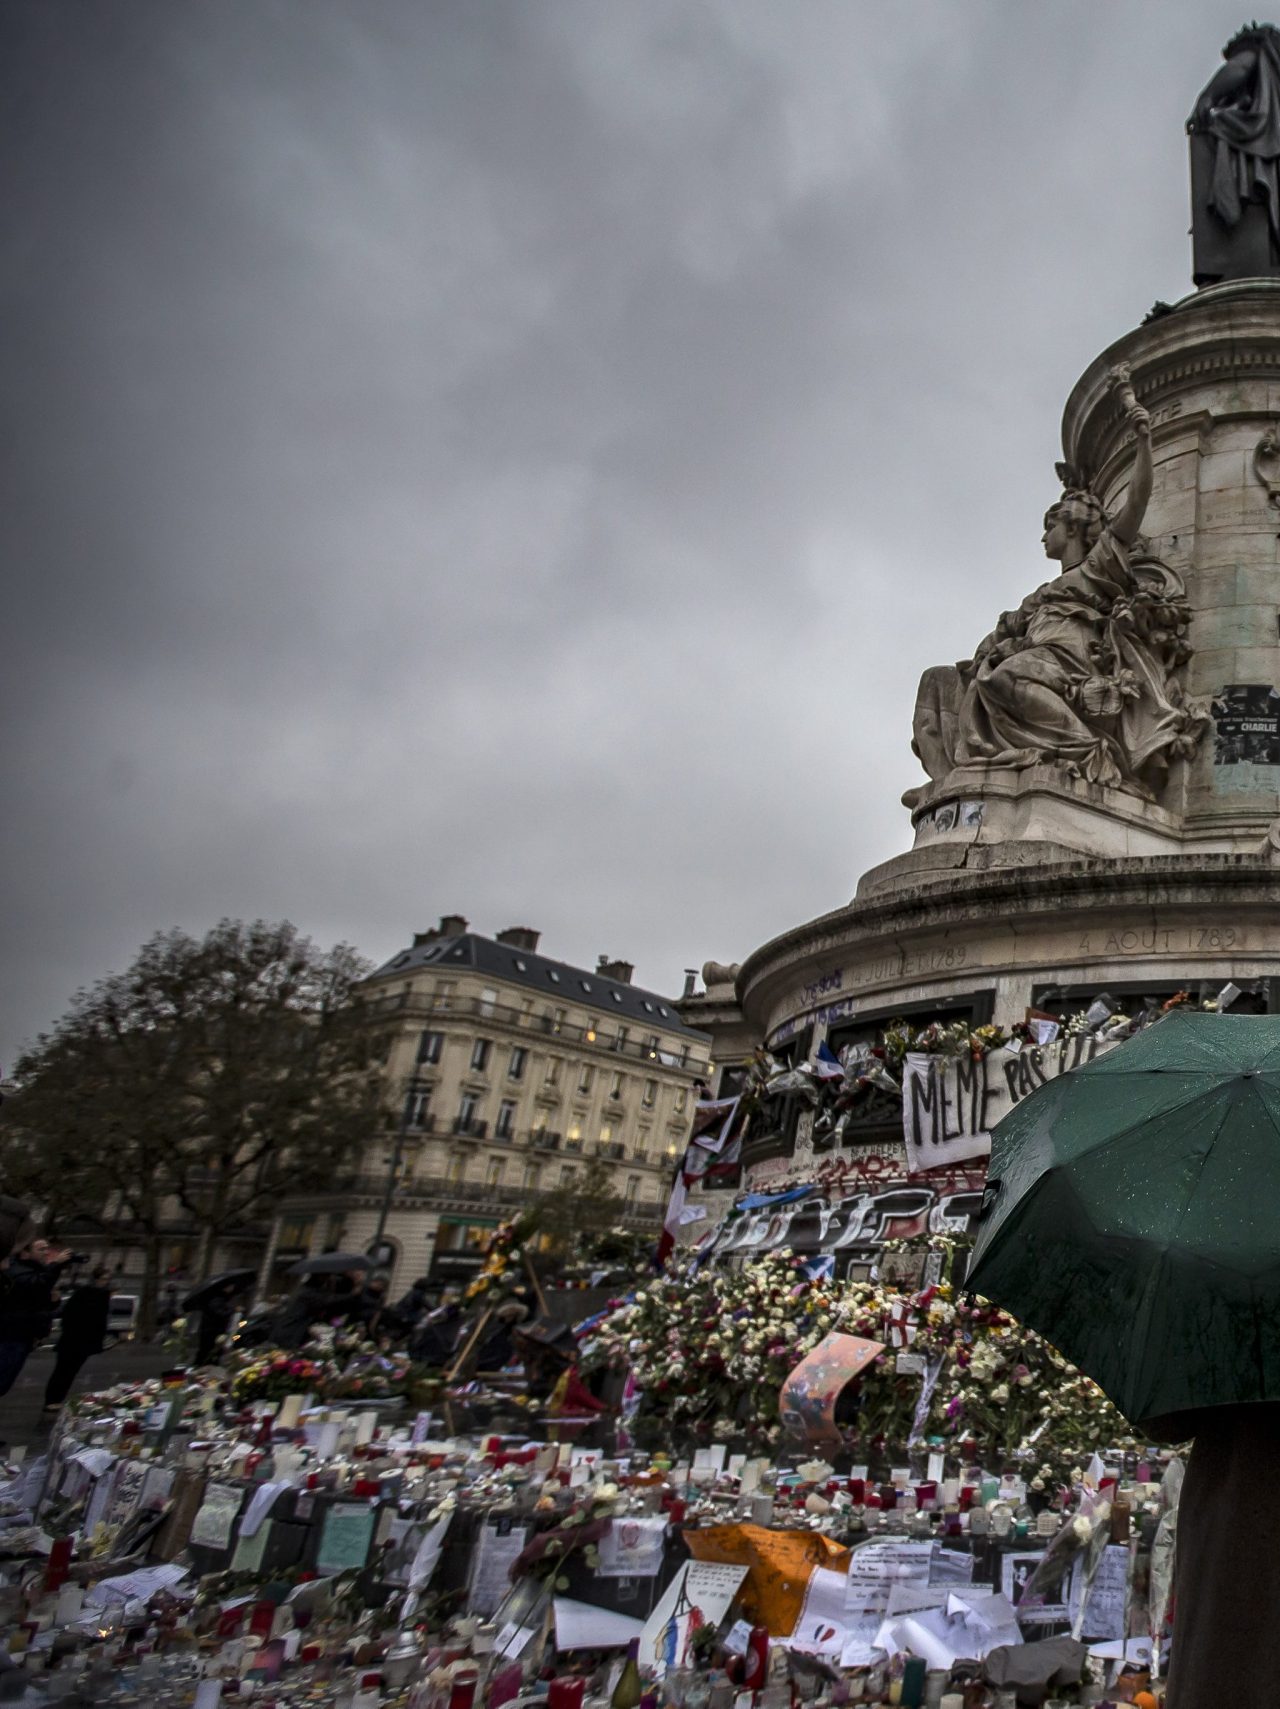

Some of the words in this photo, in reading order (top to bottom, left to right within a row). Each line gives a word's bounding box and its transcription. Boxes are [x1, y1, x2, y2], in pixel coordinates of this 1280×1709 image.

[1240, 722, 1278, 732] CHARLIE
[1079, 932, 1091, 952] 4
[1104, 929, 1176, 952] AOUT
[1188, 927, 1237, 948] 1789
[930, 947, 967, 969] 1789
